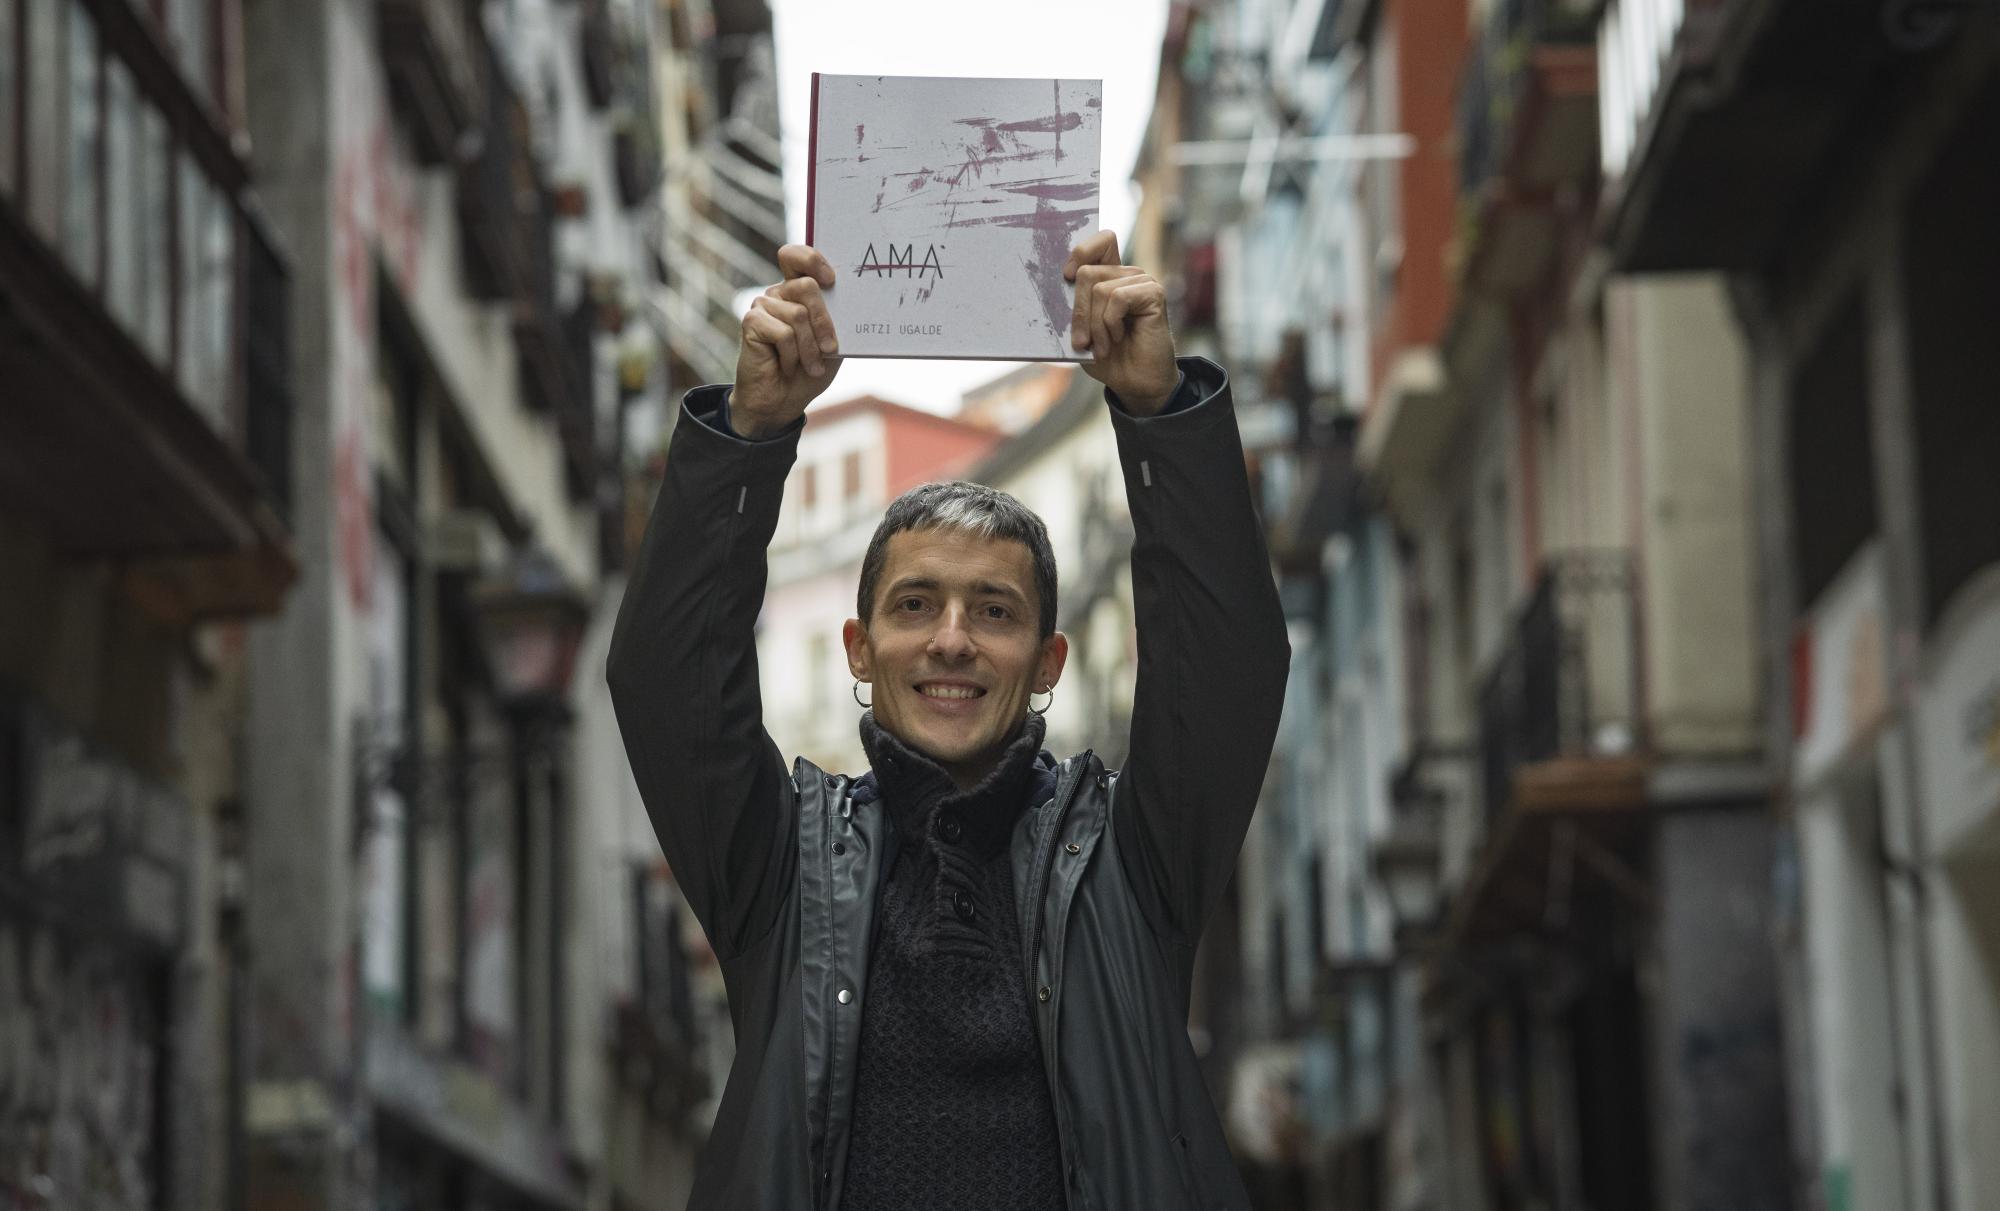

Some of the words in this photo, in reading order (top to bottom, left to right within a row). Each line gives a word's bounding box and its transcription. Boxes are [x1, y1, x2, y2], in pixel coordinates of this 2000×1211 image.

[857, 242, 943, 279] AMA
[855, 323, 891, 335] URTZI
[899, 324, 943, 336] UGALDE
